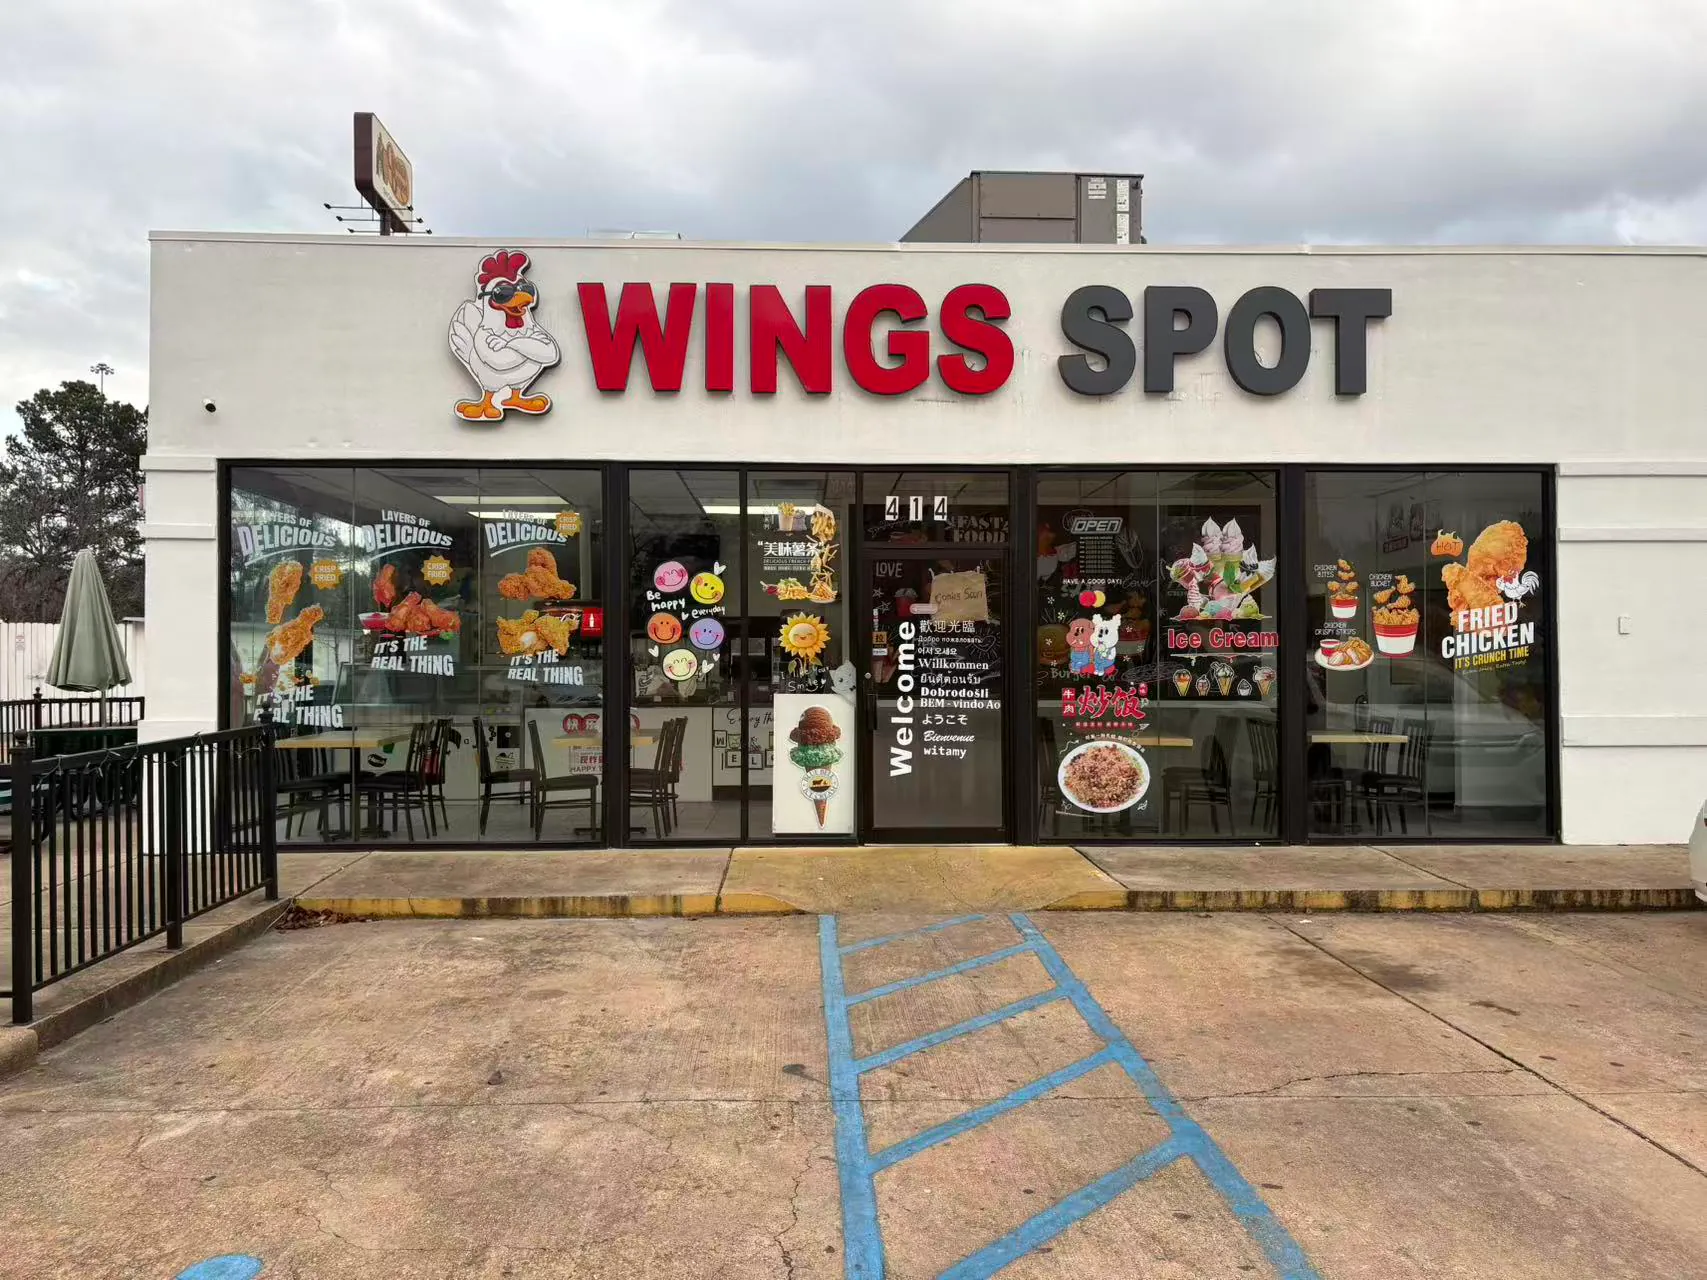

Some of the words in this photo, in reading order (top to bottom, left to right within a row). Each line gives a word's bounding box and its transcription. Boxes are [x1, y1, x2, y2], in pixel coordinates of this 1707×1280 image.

[576, 282, 1014, 395] WINGS
[1057, 284, 1392, 396] SPOT
[886, 497, 947, 520] 414
[299, 516, 312, 528] OF
[381, 509, 416, 525] LAYERS
[419, 516, 431, 528] OF
[1074, 520, 1120, 531] OPEN
[237, 523, 337, 556] DELICIOUS
[362, 524, 454, 554] DELICIOUS
[484, 522, 568, 549] DELICIOUS
[1436, 541, 1460, 551] HOT
[427, 563, 448, 571] CRISP
[427, 571, 447, 579] FRIED
[875, 562, 903, 578] LOVE
[646, 590, 662, 602] Be
[651, 597, 686, 613] happy
[691, 605, 727, 619] everyday
[919, 619, 976, 633] 歡迎光臨
[1458, 602, 1518, 633] FRIED
[374, 642, 399, 654] IT'S
[403, 635, 428, 651] THE
[1167, 628, 1202, 649] Ice
[1208, 627, 1279, 649] Cream
[1441, 621, 1535, 659] CHICKEN
[510, 654, 533, 666] IT'S
[537, 649, 560, 663] THE
[918, 657, 989, 670] Willkommen
[1455, 656, 1471, 669] IT'S
[1472, 649, 1507, 666] CRUNCH
[1509, 645, 1530, 660] TIME
[371, 656, 408, 672] REAL
[410, 655, 455, 677] THING
[507, 667, 539, 682] REAL
[543, 666, 584, 686] THING
[287, 685, 314, 703] THE
[890, 621, 916, 777] Welcome
[920, 686, 989, 698] Dobrodošli
[920, 698, 945, 708] BEM
[953, 699, 984, 709] vindo
[986, 701, 1001, 710] Ao
[1077, 684, 1146, 720] 炒饭
[253, 706, 290, 724] RAL
[296, 705, 344, 728] THING
[922, 713, 968, 725] ようこそ
[923, 730, 976, 742] Bienvenue
[923, 745, 967, 759] witamy
